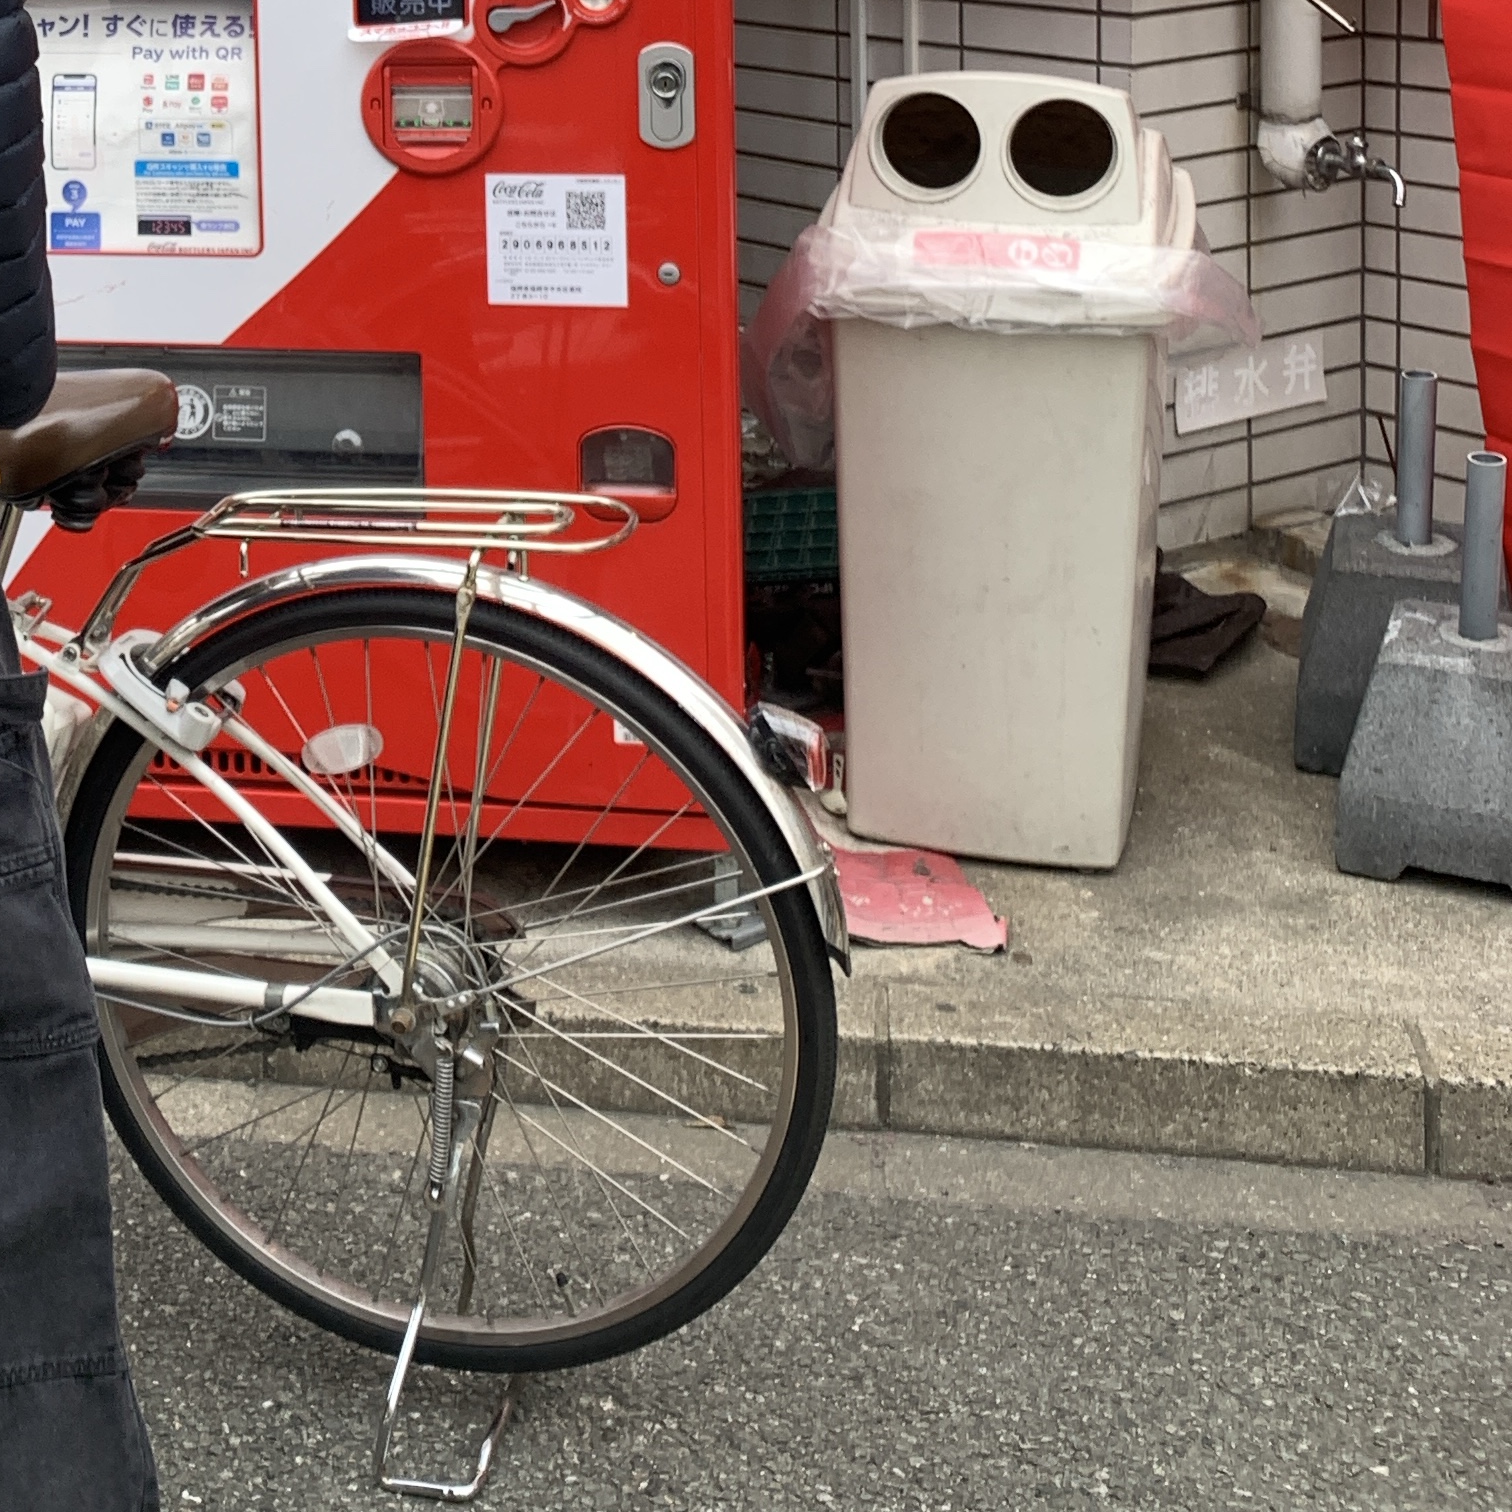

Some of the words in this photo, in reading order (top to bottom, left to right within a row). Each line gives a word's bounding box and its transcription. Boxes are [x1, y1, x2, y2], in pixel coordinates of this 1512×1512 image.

[101, 13, 255, 39] すぐに使える!
[131, 47, 164, 62] Pay
[169, 46, 209, 61] with
[215, 46, 243, 61] QR
[492, 180, 546, 199] Coca-Cola
[65, 217, 87, 227] PAY
[151, 220, 186, 234] 12345
